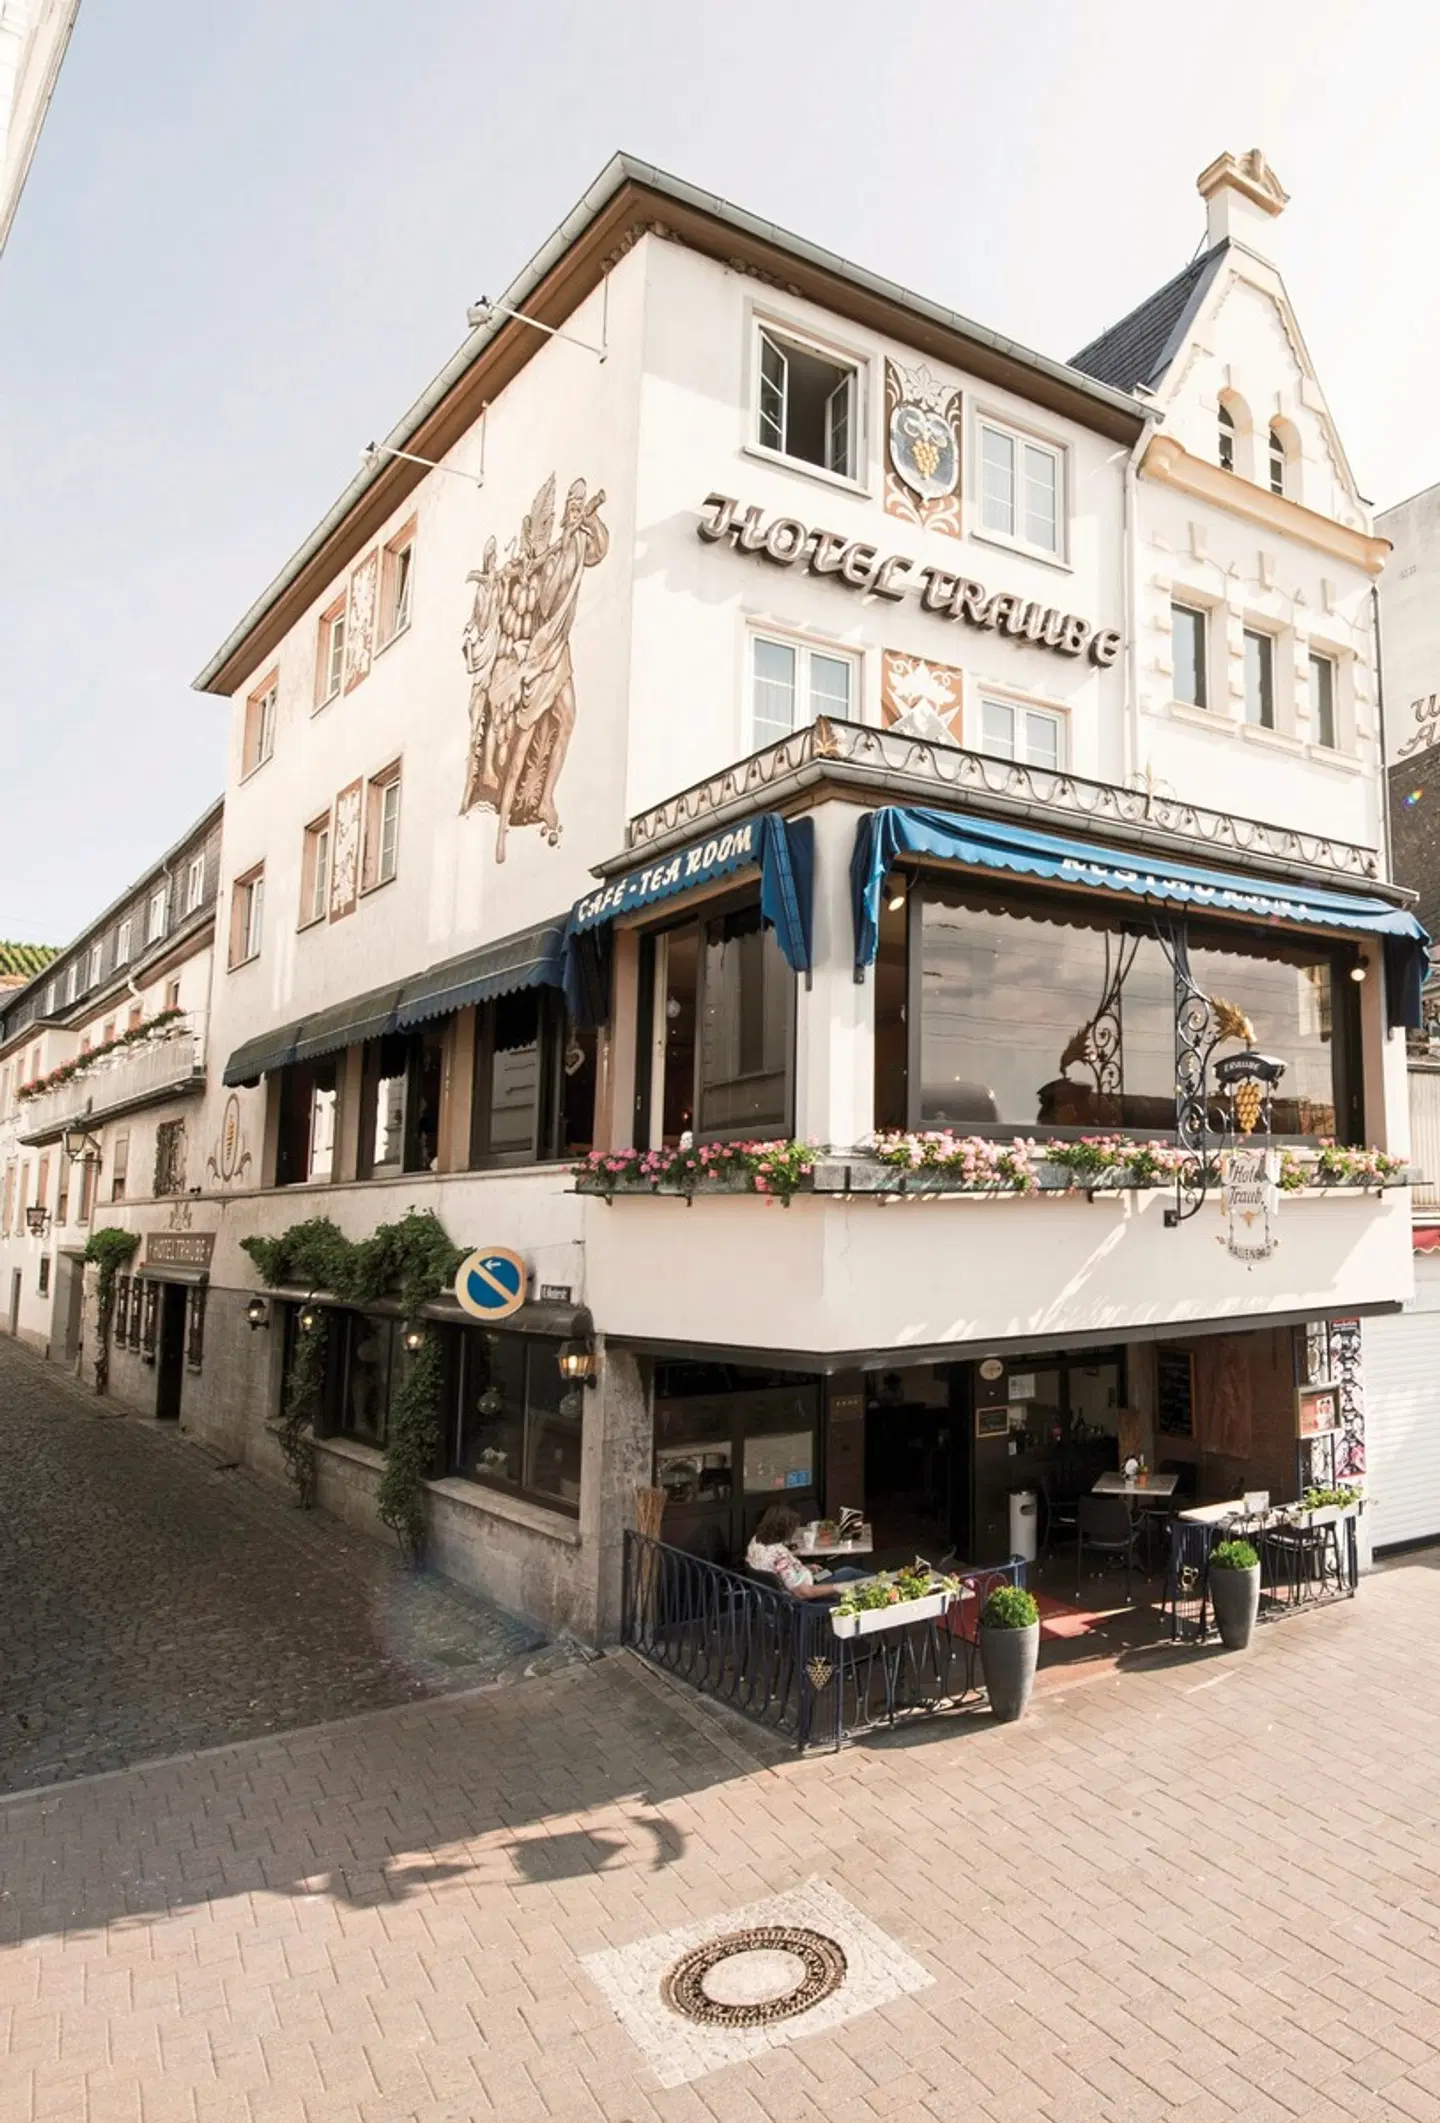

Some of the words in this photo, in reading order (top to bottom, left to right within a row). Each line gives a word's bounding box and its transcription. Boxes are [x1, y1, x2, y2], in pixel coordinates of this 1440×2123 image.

[698, 492, 915, 602] HOTEL
[920, 565, 1121, 668] TRAUBE
[577, 878, 627, 923] CAFÉ
[639, 858, 681, 896] TEA
[686, 825, 752, 877] ROOM
